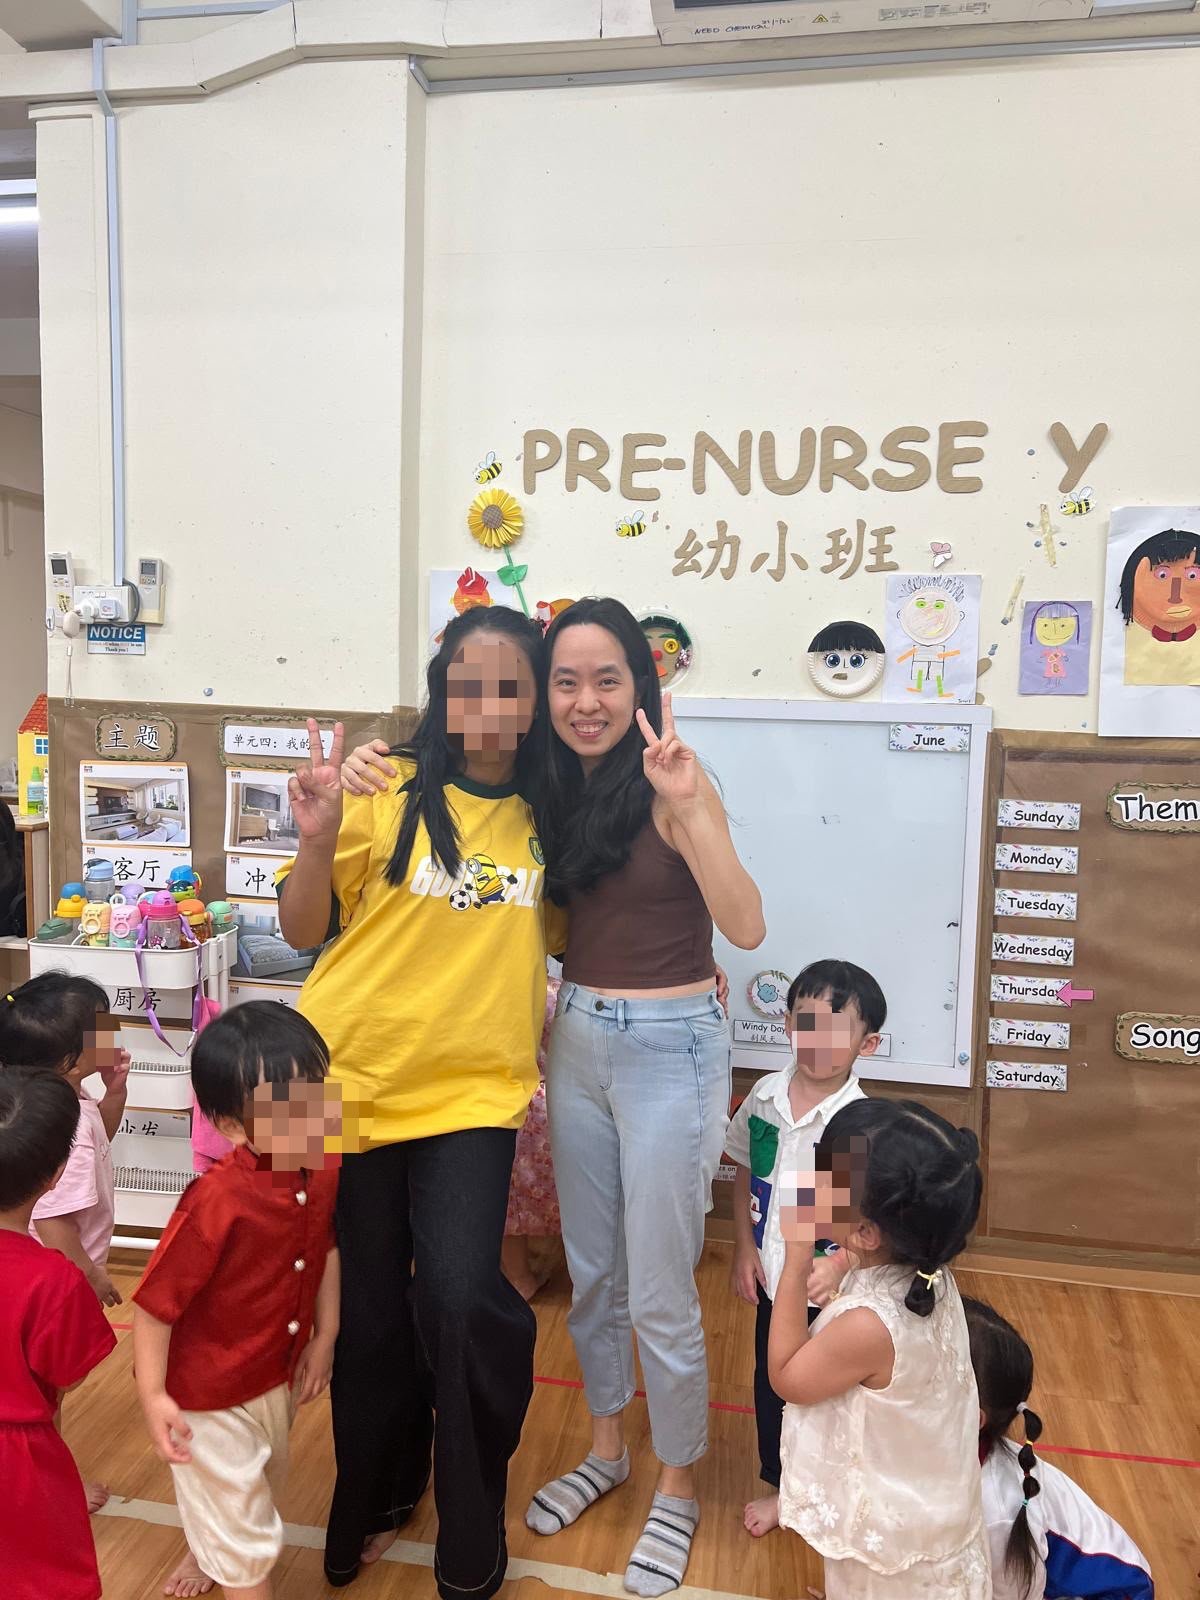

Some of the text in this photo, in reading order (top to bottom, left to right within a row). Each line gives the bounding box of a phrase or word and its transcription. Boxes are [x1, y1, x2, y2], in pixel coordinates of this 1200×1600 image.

[694, 27, 720, 35] NEED
[523, 420, 1108, 501] PRE-NURSE Y
[672, 519, 900, 582] 幼小班
[89, 625, 143, 640] NOTICE
[104, 723, 160, 750] 主题
[913, 734, 945, 746] June
[1115, 795, 1198, 820] Them
[1014, 809, 1064, 826] Sunday
[113, 857, 161, 882] 客厅
[1010, 852, 1063, 868] Monday
[245, 867, 276, 894] 冲
[1008, 897, 1065, 915] Tuesday
[994, 941, 1073, 962] Wednesday
[113, 988, 162, 1012] 厨房
[742, 1022, 768, 1034] Windy
[1007, 1028, 1052, 1045] Friday
[1131, 1023, 1200, 1054] Song
[995, 1070, 1059, 1087] Saturday
